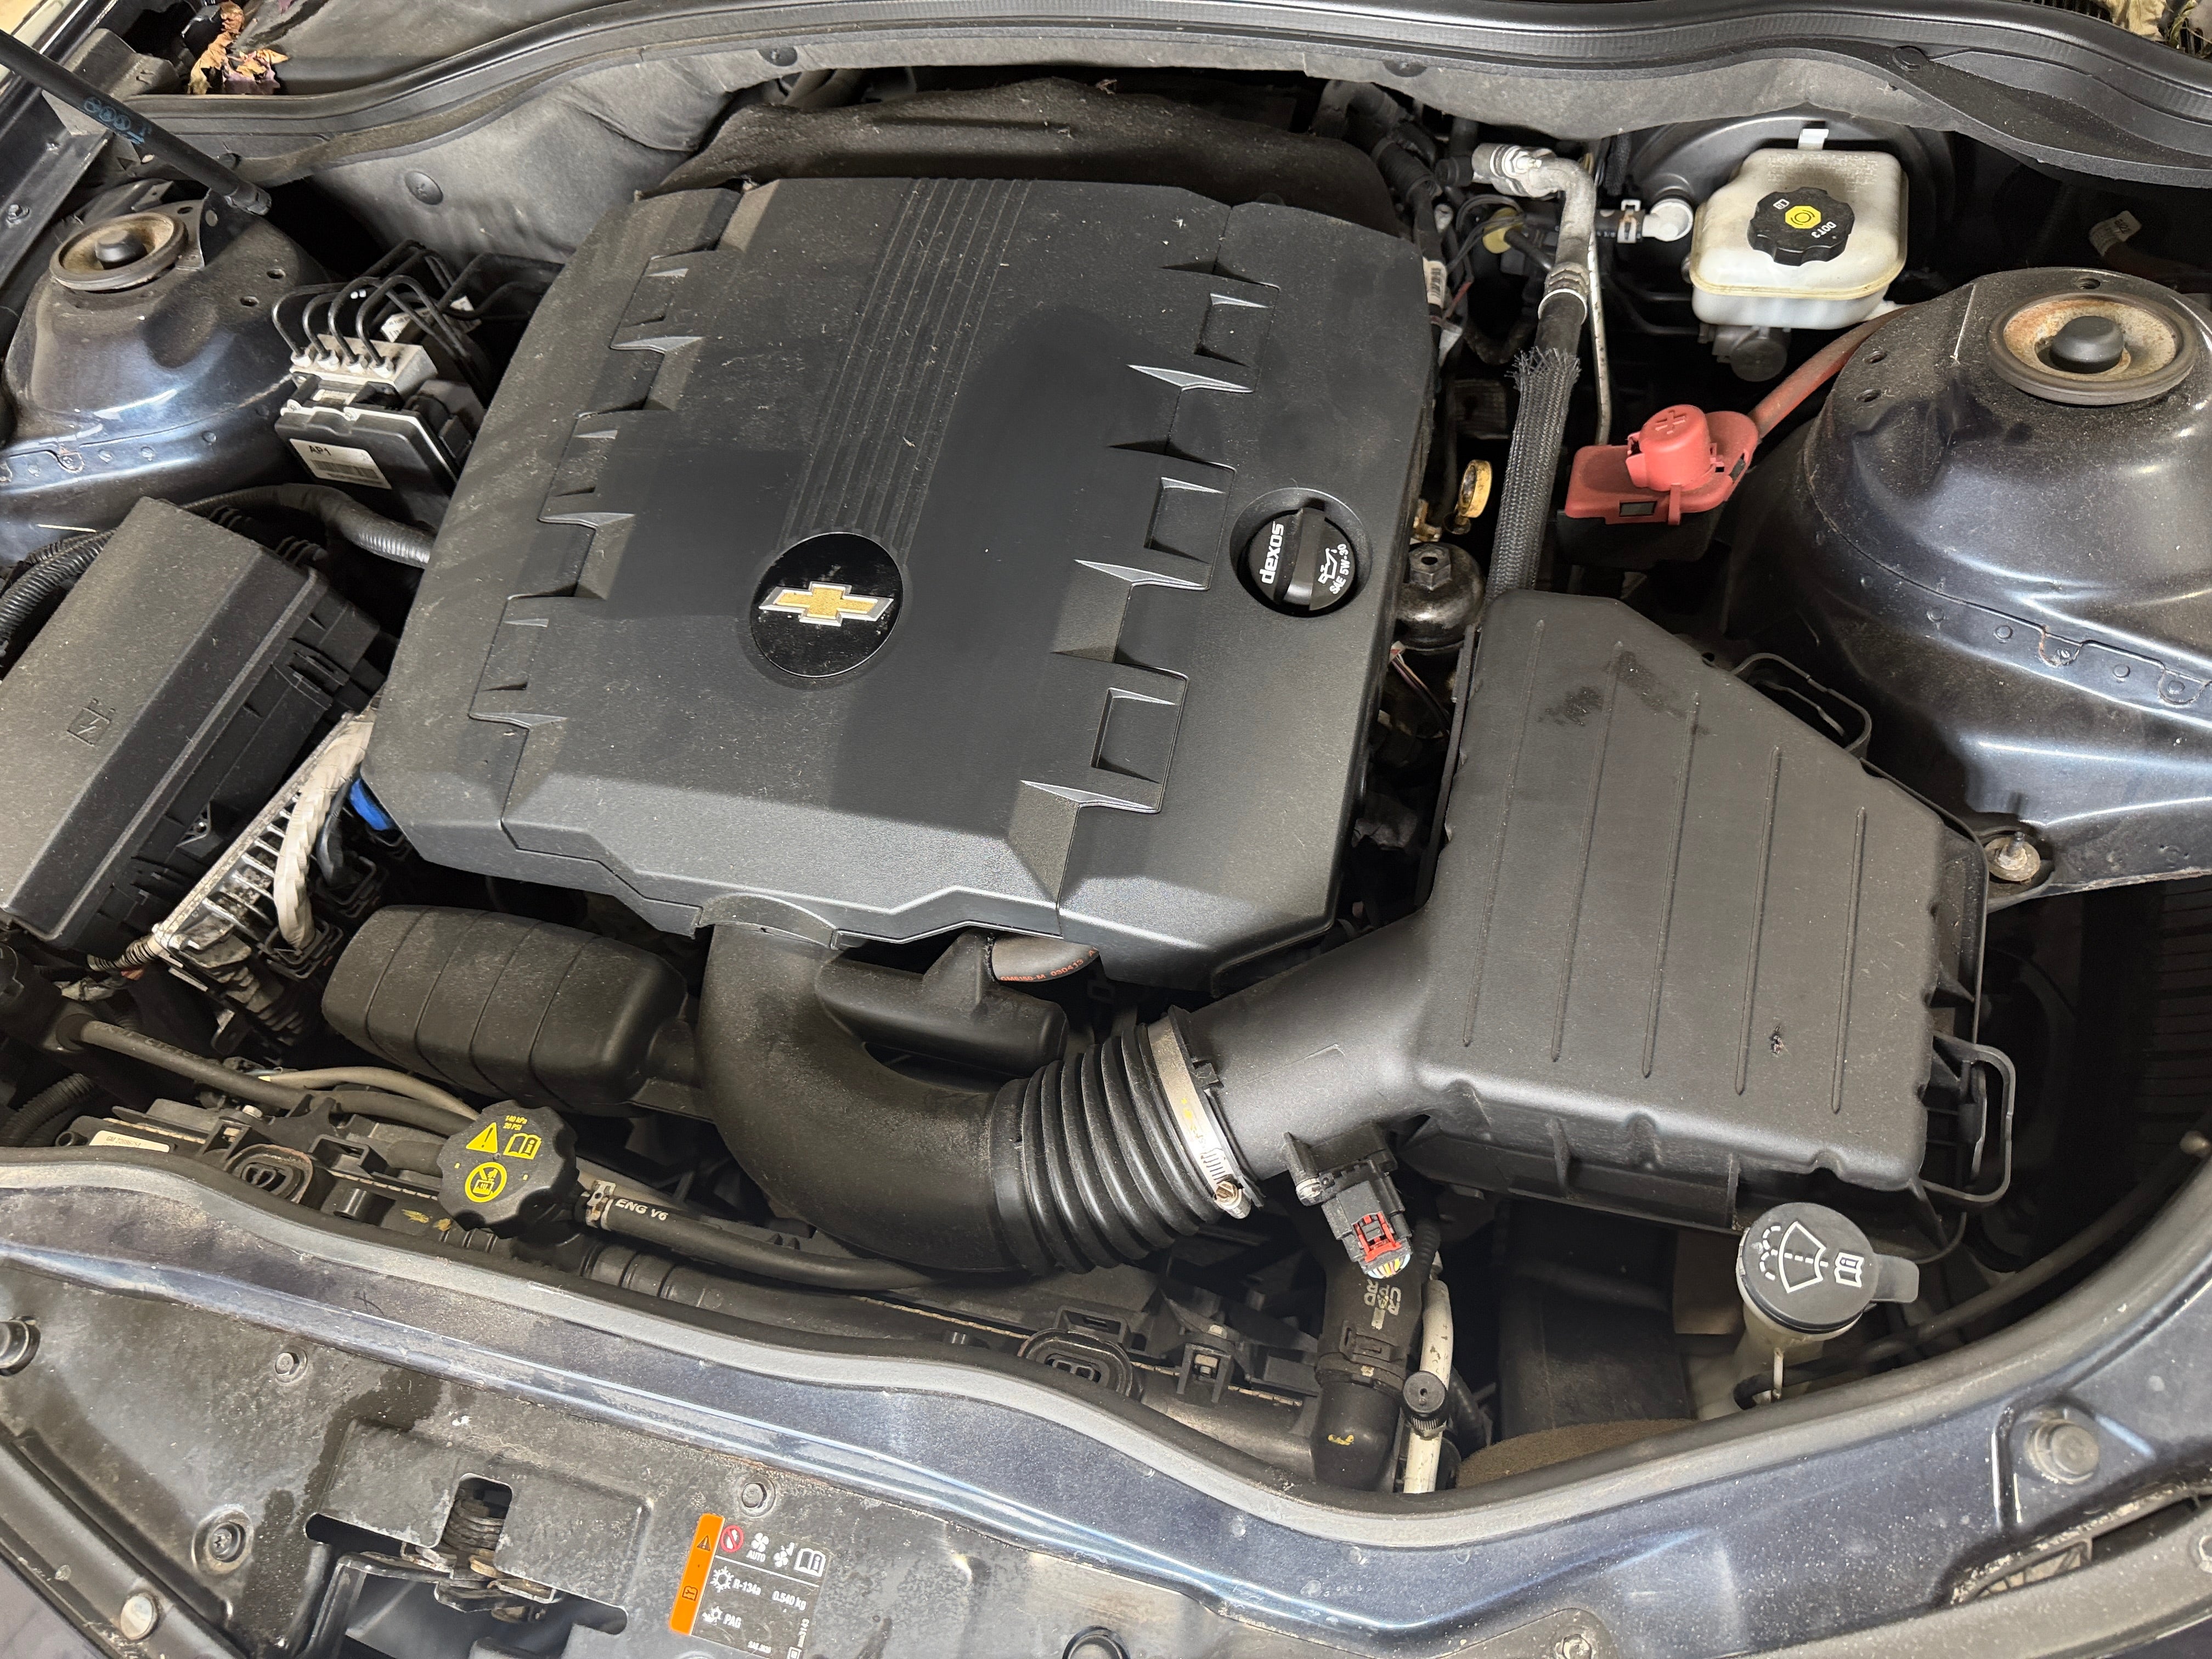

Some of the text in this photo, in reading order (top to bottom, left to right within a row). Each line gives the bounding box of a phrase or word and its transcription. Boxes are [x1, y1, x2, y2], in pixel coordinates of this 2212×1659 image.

[1811, 221, 1837, 238] DOT3
[308, 445, 331, 456] AP1
[1259, 521, 1284, 584] dexos
[1329, 543, 1350, 595] SAE 5W-30
[615, 1199, 669, 1221] ENG V6
[746, 1550, 767, 1563] AUTO
[732, 1578, 808, 1611] R-134a 0.540 kg
[723, 1613, 743, 1629] PAG
